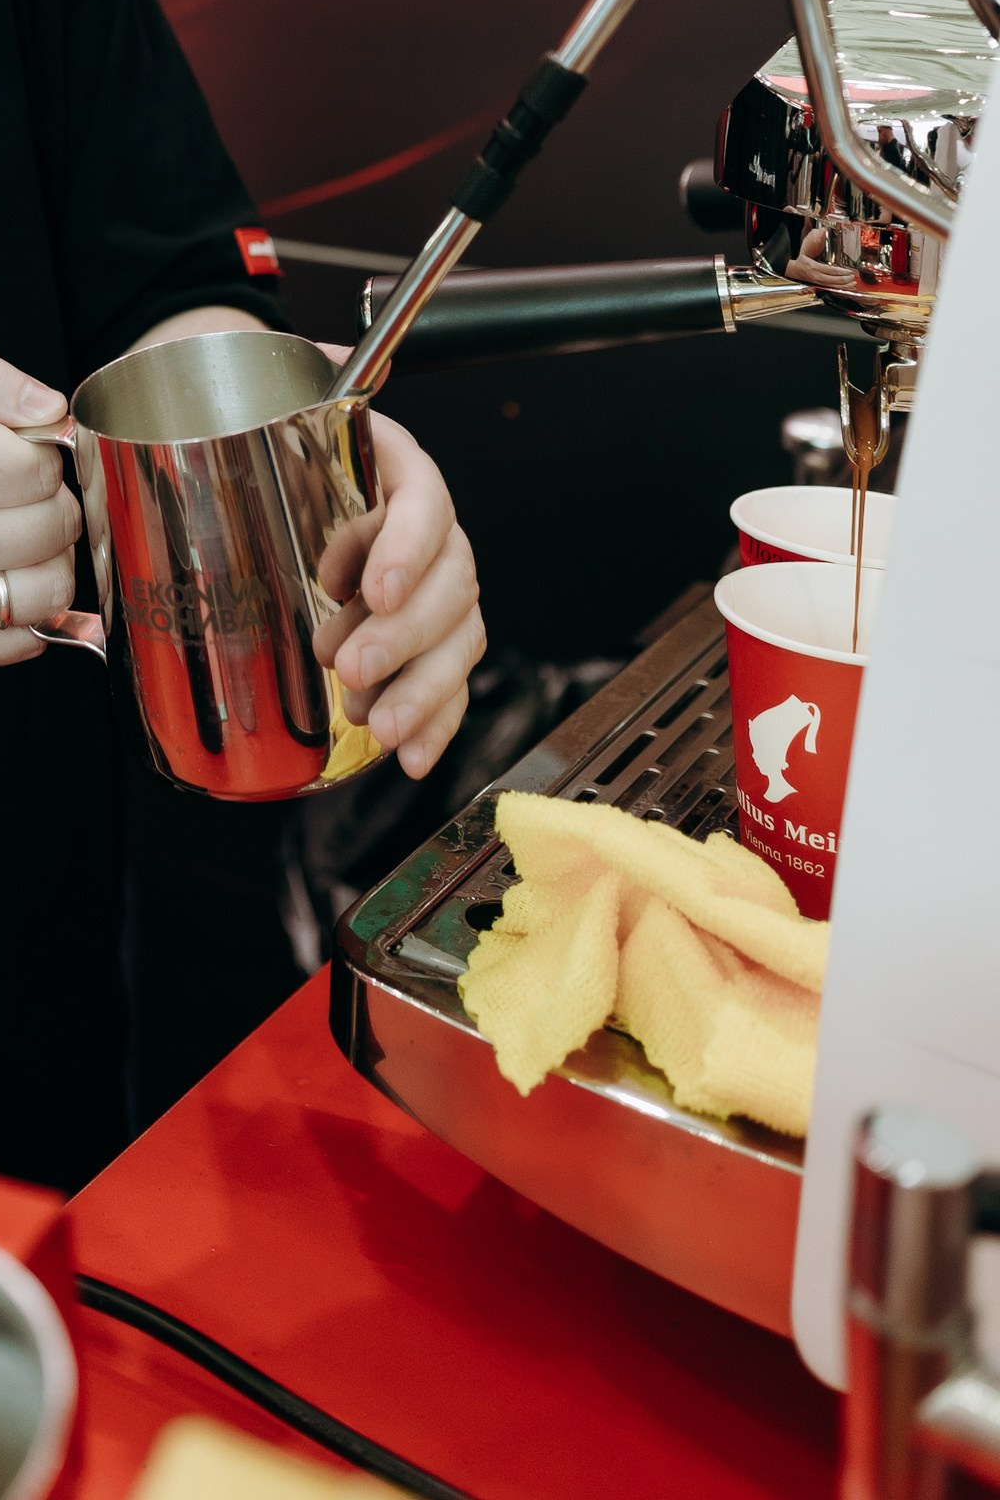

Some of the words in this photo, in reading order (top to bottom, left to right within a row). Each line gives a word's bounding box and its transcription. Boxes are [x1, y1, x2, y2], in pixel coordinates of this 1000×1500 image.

[131, 578, 268, 609] EKONIVA
[736, 784, 775, 831] ulius
[784, 819, 838, 853] Mei
[745, 828, 782, 862] Vienna
[785, 854, 825, 878] 1862
